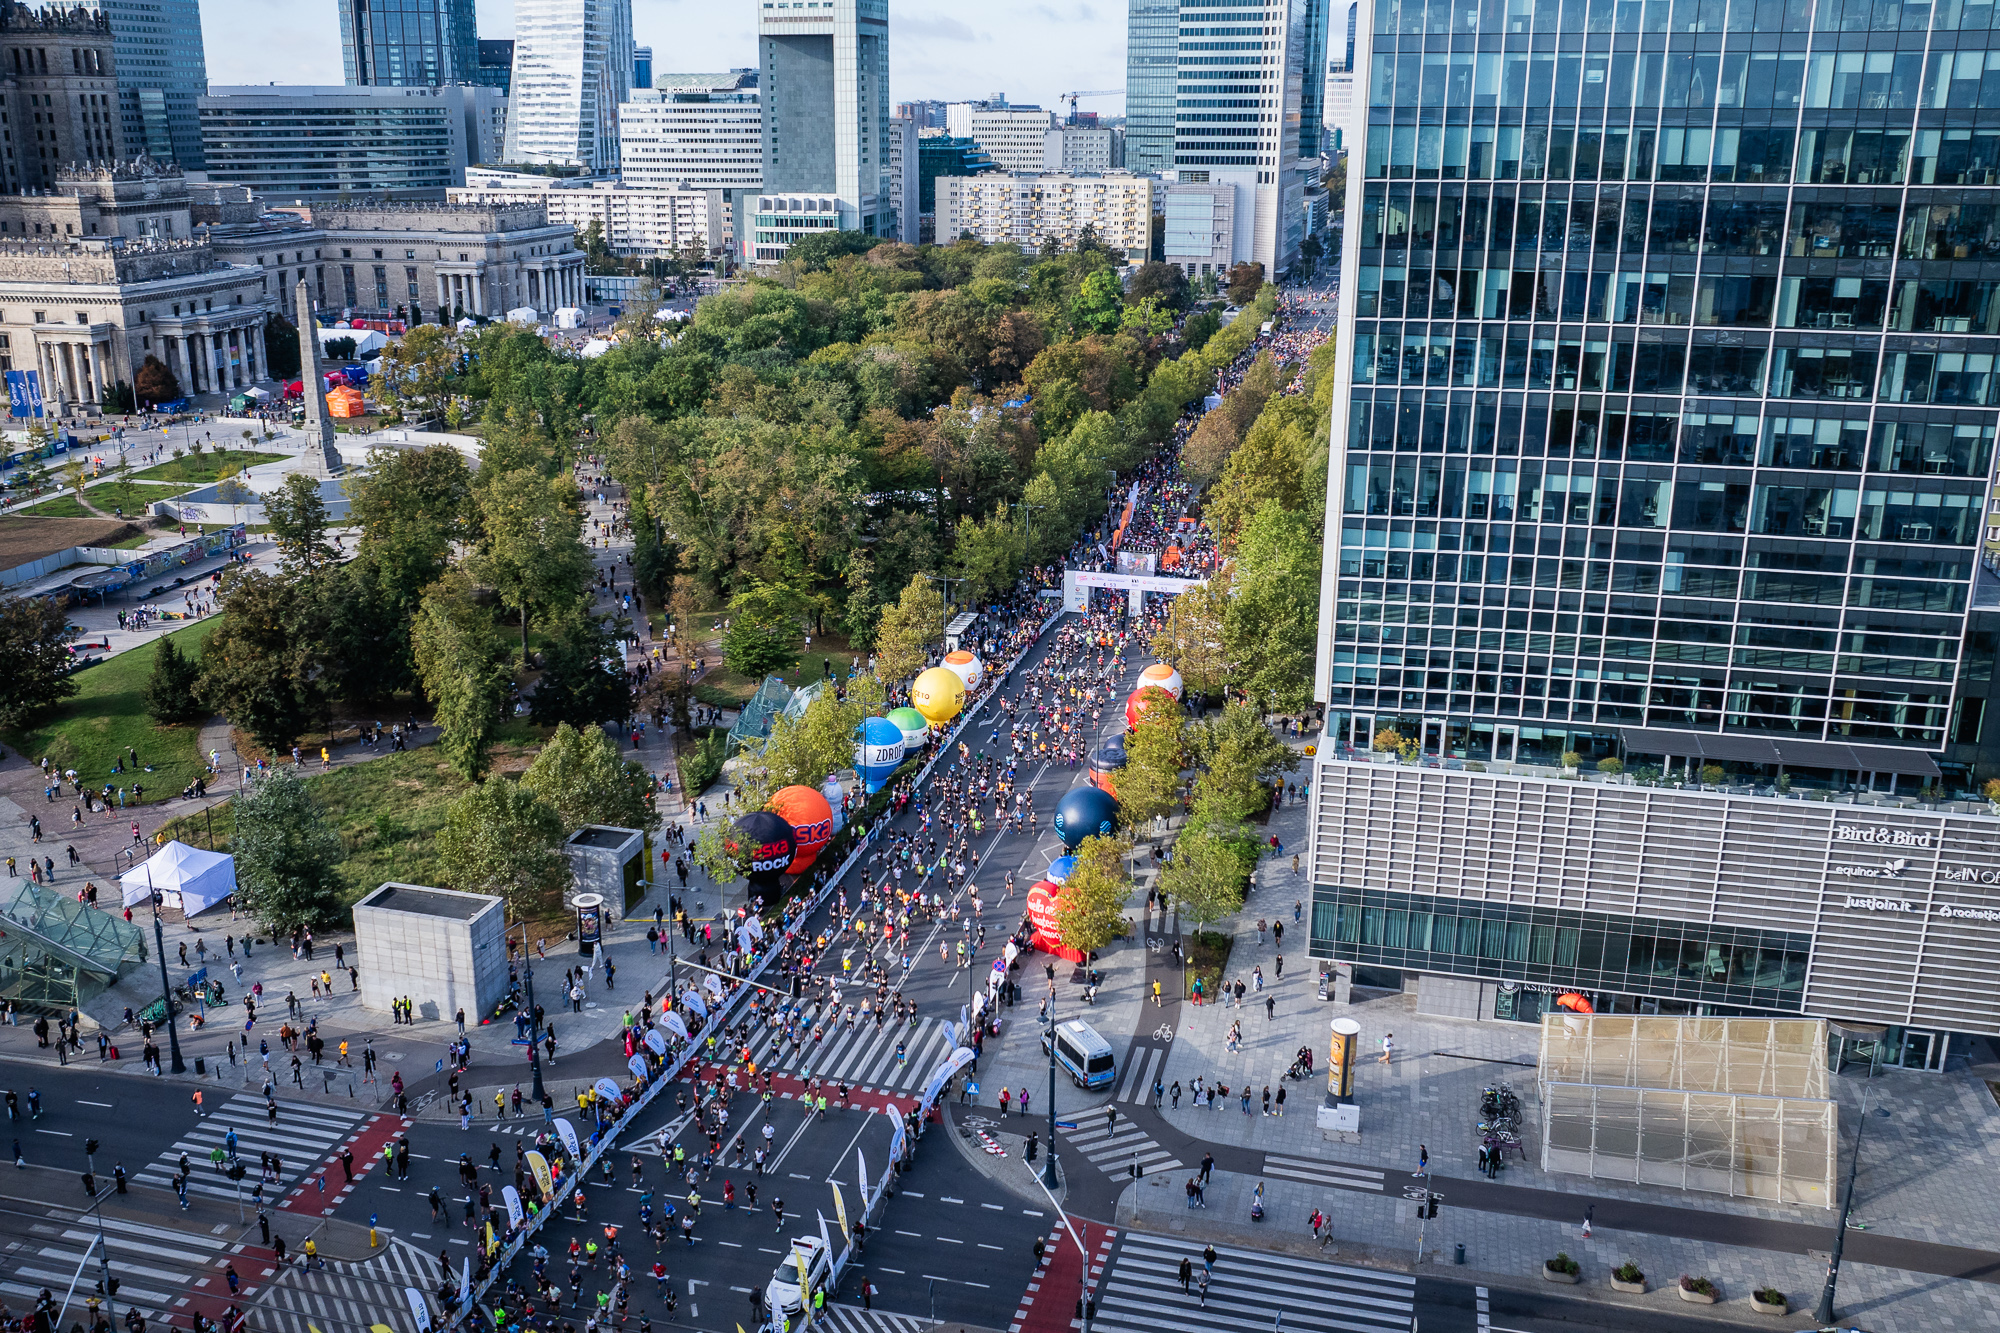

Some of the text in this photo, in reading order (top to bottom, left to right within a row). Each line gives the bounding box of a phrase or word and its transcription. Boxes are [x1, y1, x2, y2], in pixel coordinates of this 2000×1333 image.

[667, 85, 712, 93] accenture
[752, 854, 790, 872] ROCK
[1836, 866, 1880, 877] equinor
[1844, 896, 1912, 913] justjoin.it
